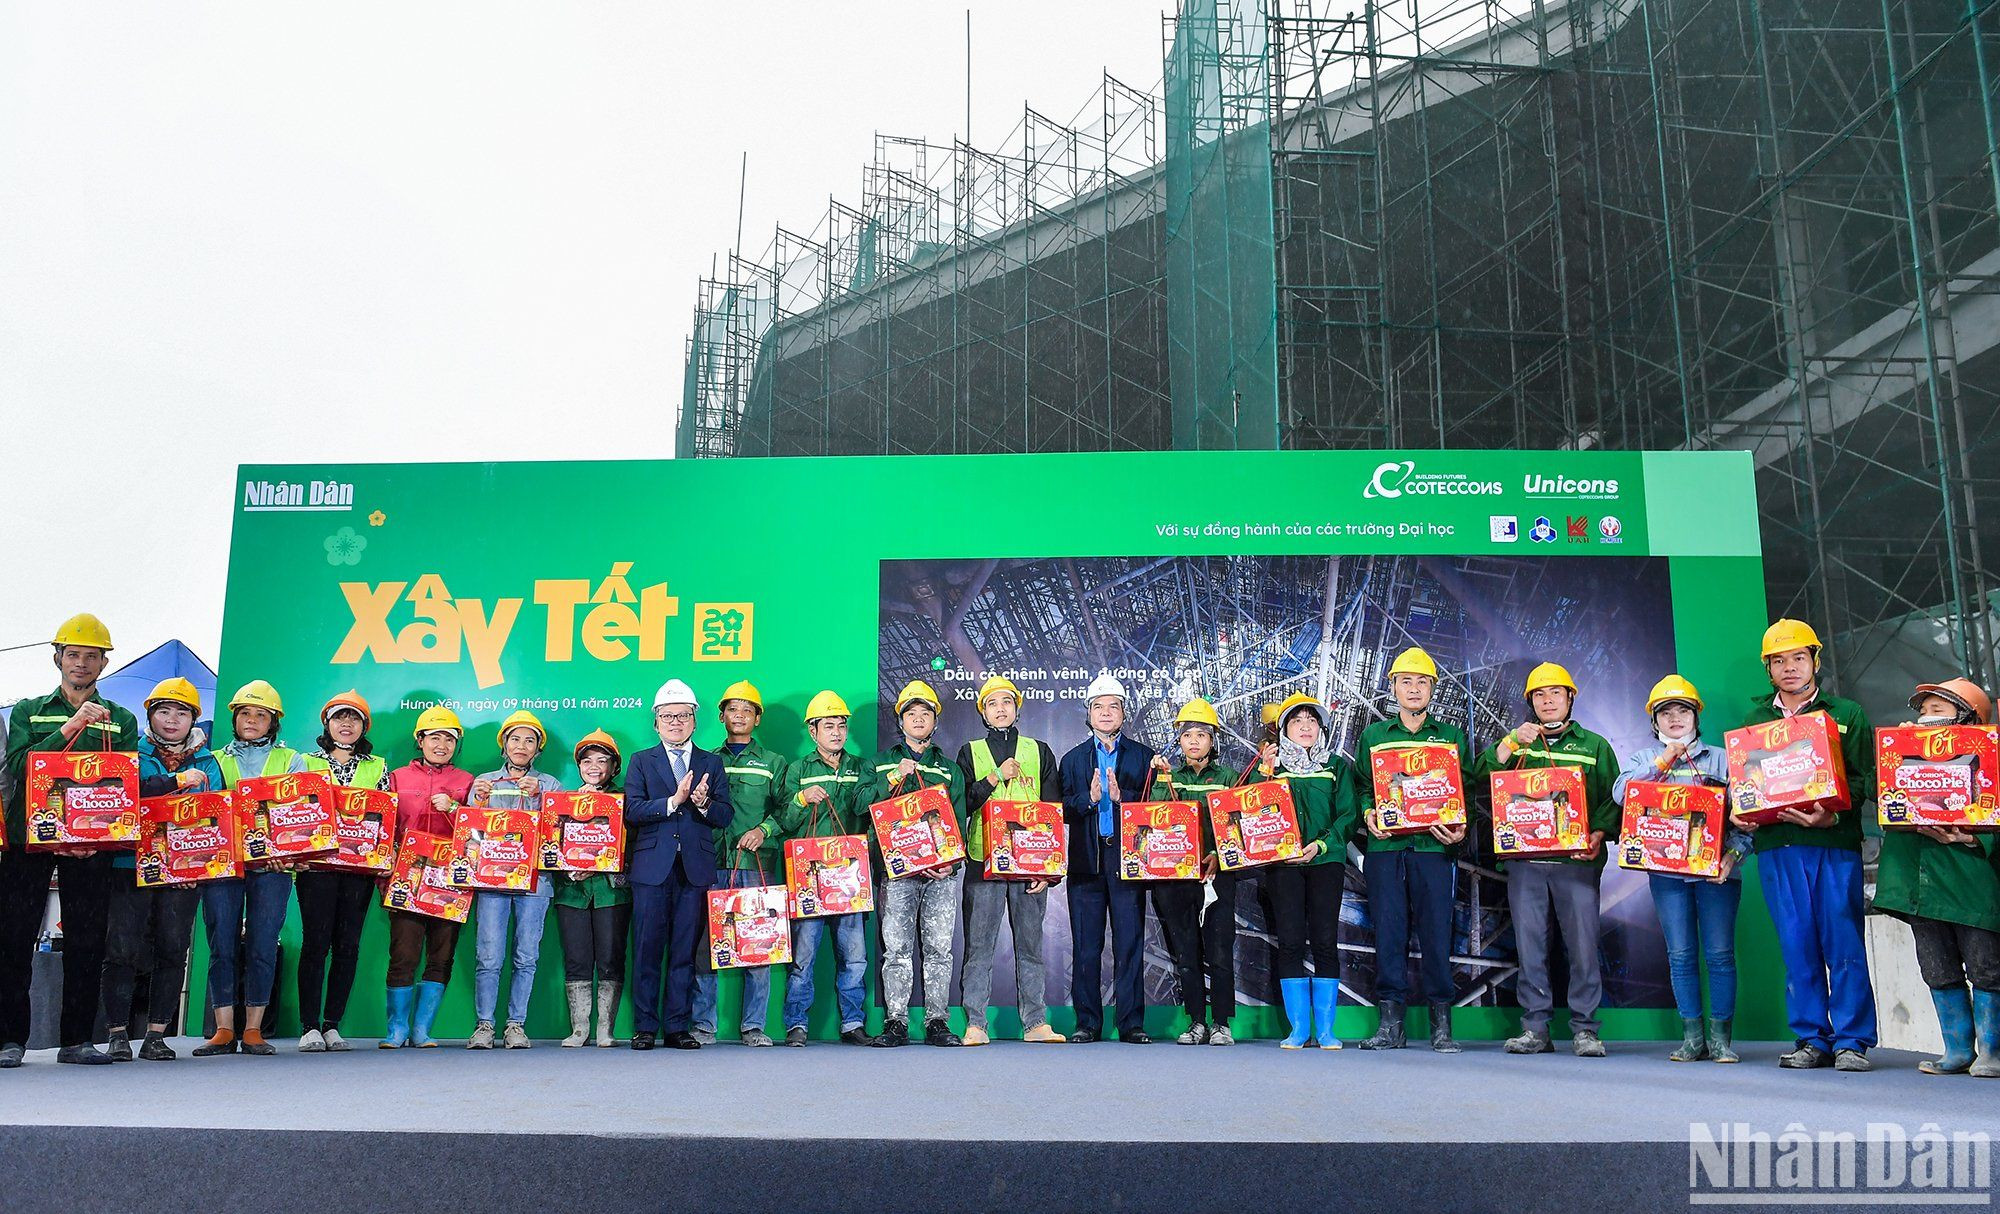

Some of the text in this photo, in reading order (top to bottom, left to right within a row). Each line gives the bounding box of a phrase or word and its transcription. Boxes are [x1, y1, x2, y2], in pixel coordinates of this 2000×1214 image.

[244, 480, 354, 505] Nhân Dân
[1523, 474, 1619, 493] Unicons
[1155, 520, 1455, 539] Với sự đồng hành của các trường Đại học
[328, 561, 679, 691] Xây Tết
[944, 665, 974, 681] Dẫu
[1001, 667, 1047, 681] chênh
[1052, 666, 1094, 682] vênh,
[1151, 665, 1170, 679] có
[1059, 687, 1087, 699] chã
[400, 698, 643, 711] Hưng Yên, ngày 09 tháng 01 năm 2024
[1757, 720, 1792, 749] Tết
[1915, 727, 1958, 758] Tết
[67, 753, 105, 780] Tết
[1399, 749, 1431, 773] Tết
[1766, 759, 1813, 778] ChocoP
[269, 776, 301, 801] Tết
[1406, 786, 1446, 799] ChocoP
[1519, 770, 1553, 795] Tết
[72, 798, 122, 809] ChocoP
[167, 795, 201, 822] Tết
[341, 789, 371, 811] Tết
[569, 793, 597, 817] Tết
[895, 793, 922, 819] Tết
[1234, 786, 1263, 811] Tết
[1656, 785, 1692, 812] Tết
[484, 811, 511, 832] Tết
[1013, 803, 1040, 824] Tết
[1146, 804, 1173, 827] Tết
[1507, 811, 1549, 823] hocoPie
[171, 837, 218, 851] ChocoP
[337, 828, 374, 839] ocoPie
[892, 833, 927, 848] hocoPie
[1018, 840, 1052, 849] ChocoP
[1637, 826, 1682, 841] hocoPie
[431, 838, 454, 861] Tế
[817, 838, 844, 862] Tết
